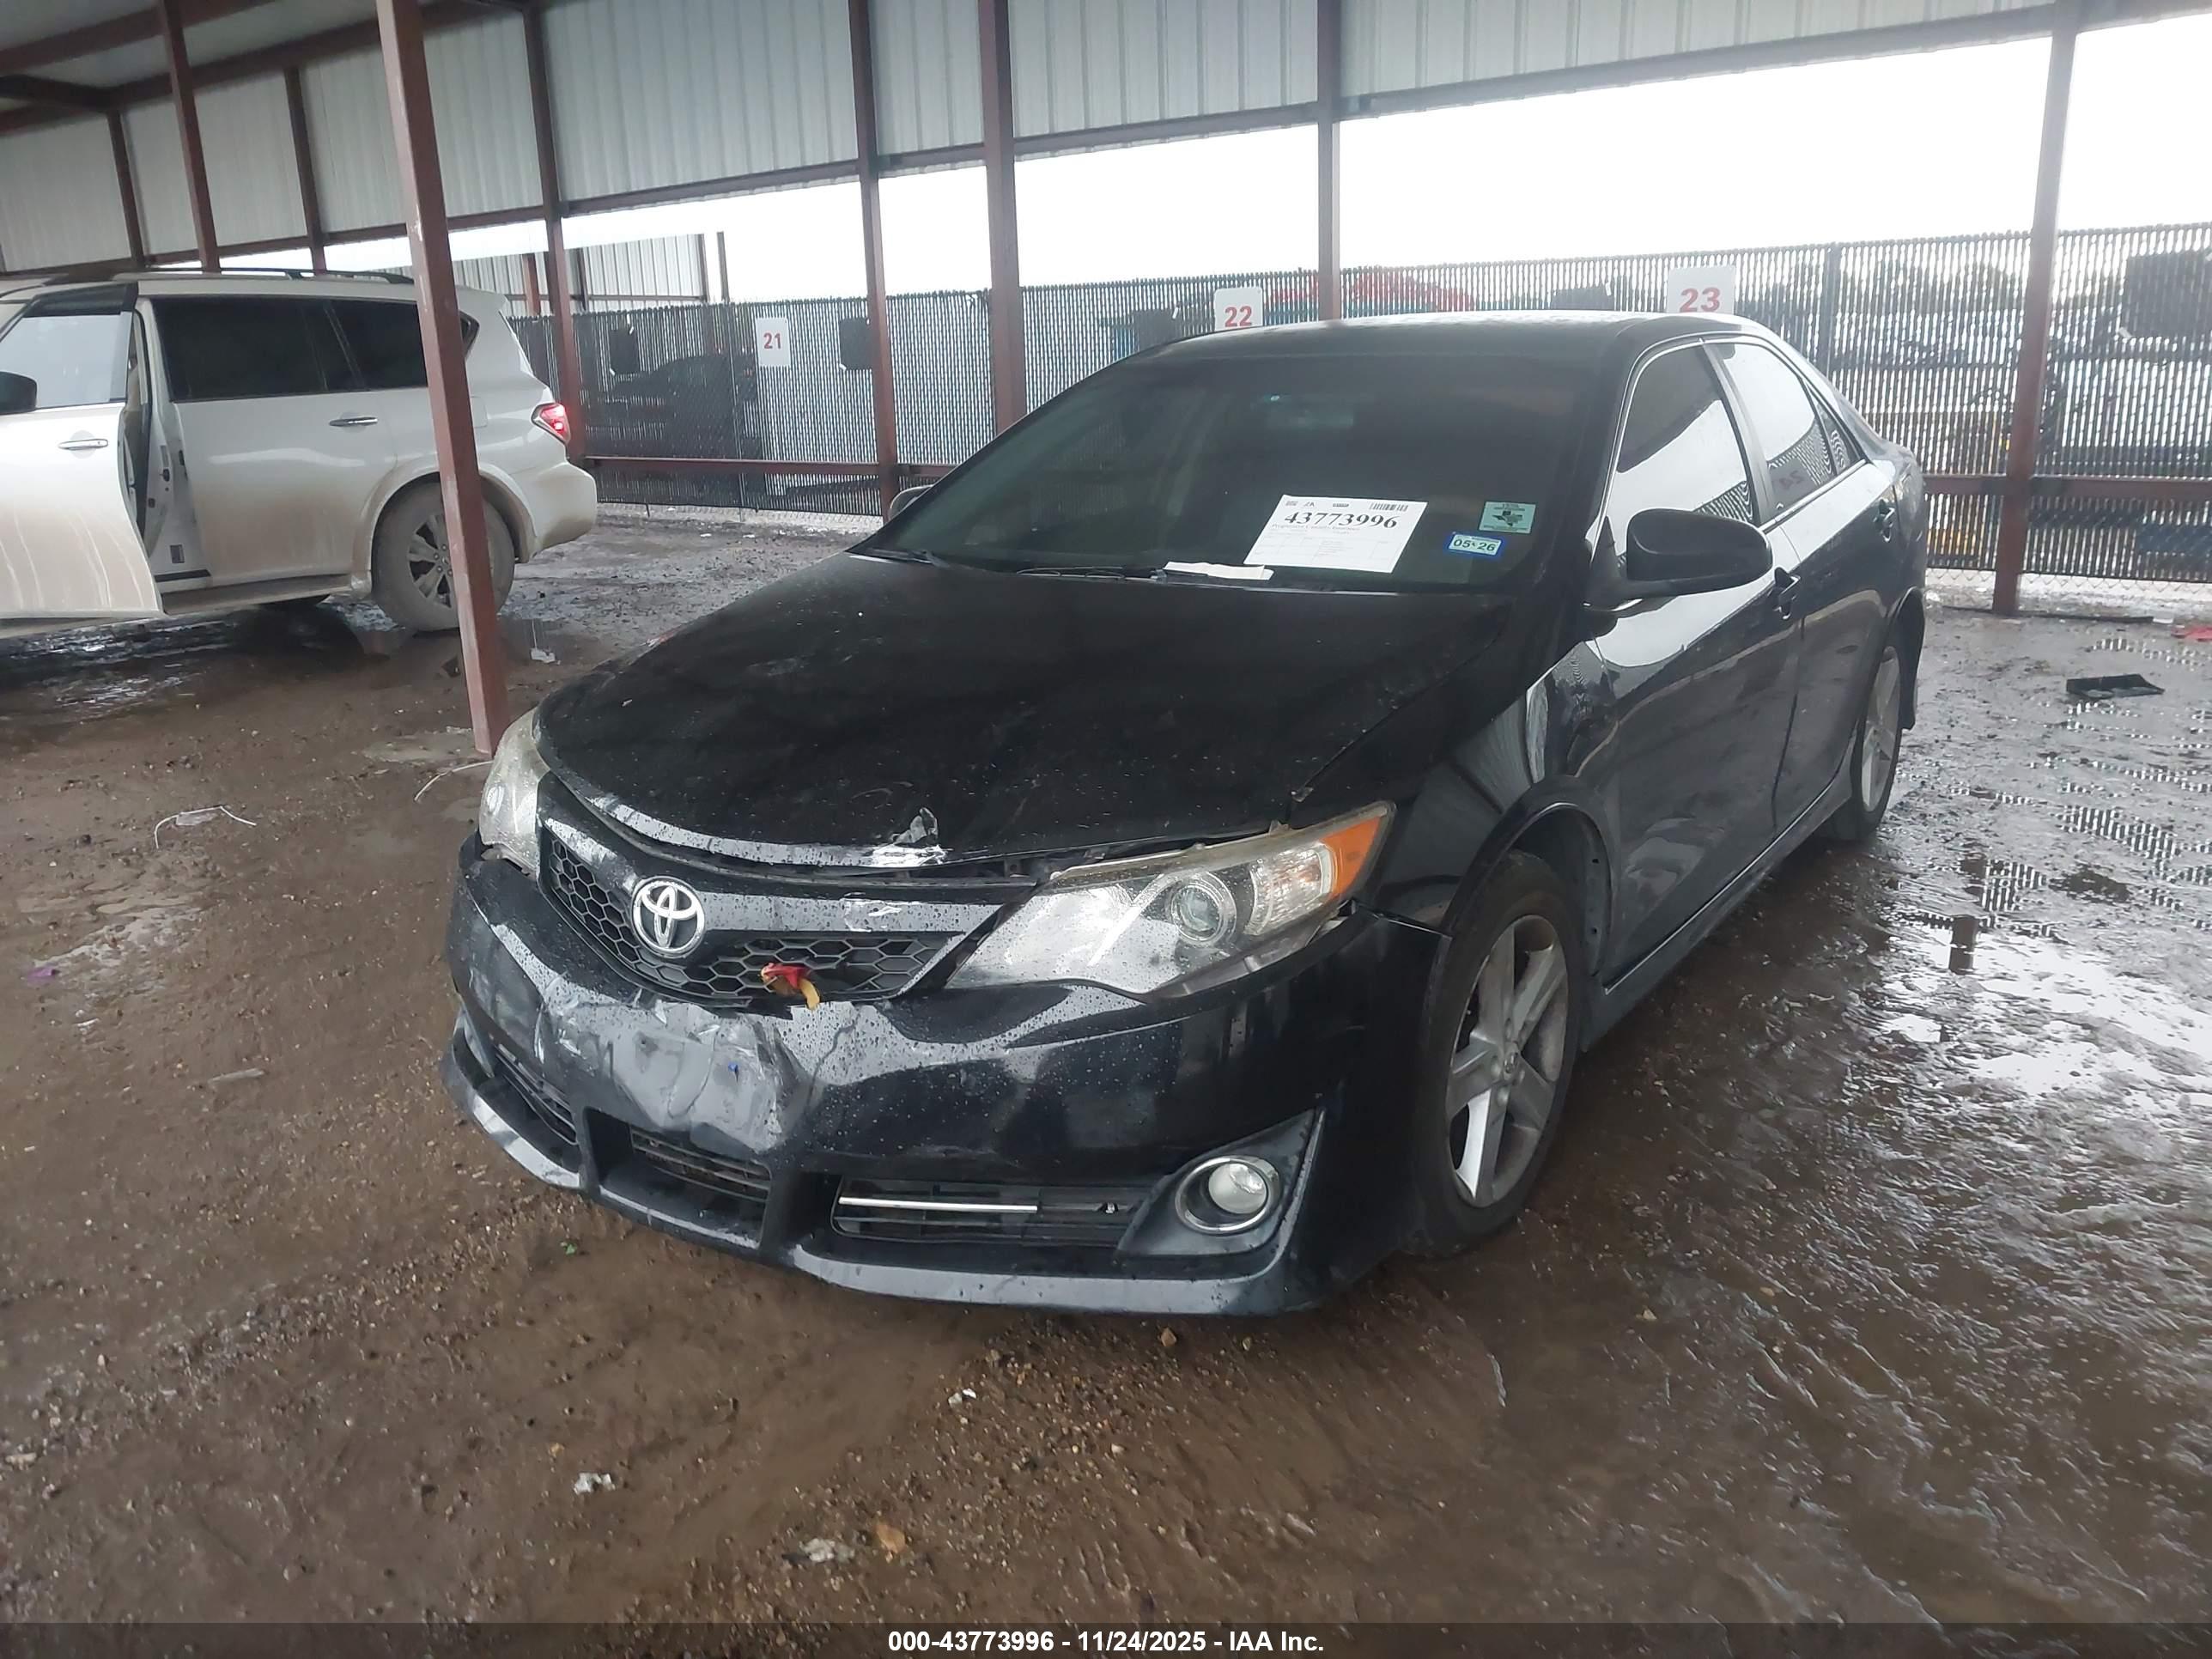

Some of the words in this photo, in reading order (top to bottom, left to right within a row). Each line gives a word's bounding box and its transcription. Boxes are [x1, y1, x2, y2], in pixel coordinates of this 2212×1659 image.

[1680, 287, 1721, 313] 23
[1224, 305, 1253, 327] 22
[763, 332, 782, 349] 21
[1284, 511, 1399, 528] 43773996
